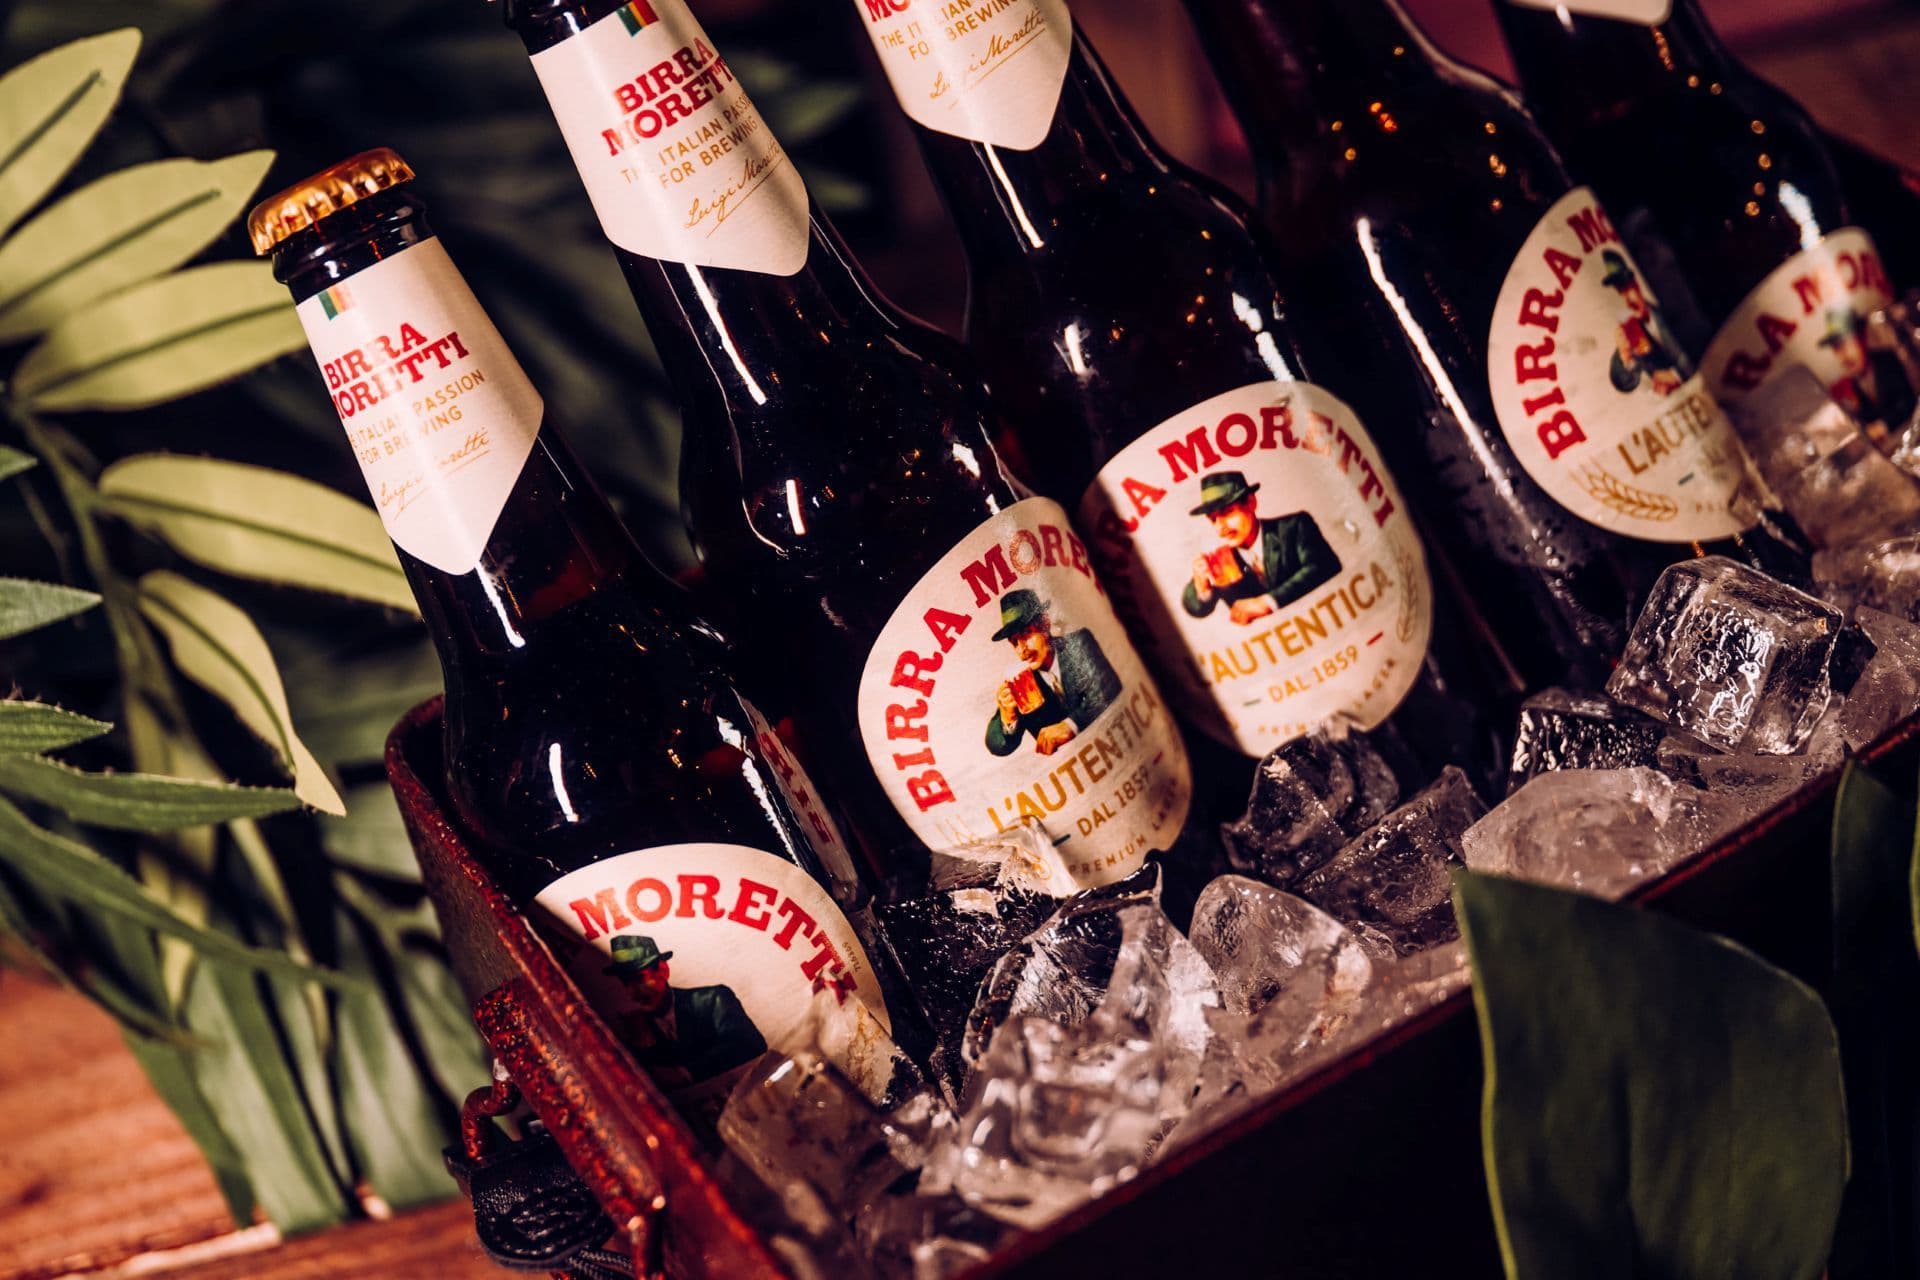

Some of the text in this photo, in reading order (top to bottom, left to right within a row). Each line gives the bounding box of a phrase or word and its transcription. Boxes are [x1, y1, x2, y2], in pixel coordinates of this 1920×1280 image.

[879, 28, 903, 49] THE
[602, 56, 733, 157] MORETT
[613, 37, 714, 115] BIRRA
[658, 118, 723, 165] ITALIAN
[659, 161, 696, 190] FOR
[699, 116, 758, 166] BREWING
[683, 177, 736, 229] Luigi
[324, 322, 427, 390] BIRRA
[1514, 246, 1587, 460] BIRRA
[356, 412, 402, 444] ITALIA
[412, 369, 486, 416] PASSION
[885, 524, 1102, 812] BIRRA MORE
[1268, 645, 1358, 703] DAL 1859
[1077, 764, 1149, 837] DAL 1859
